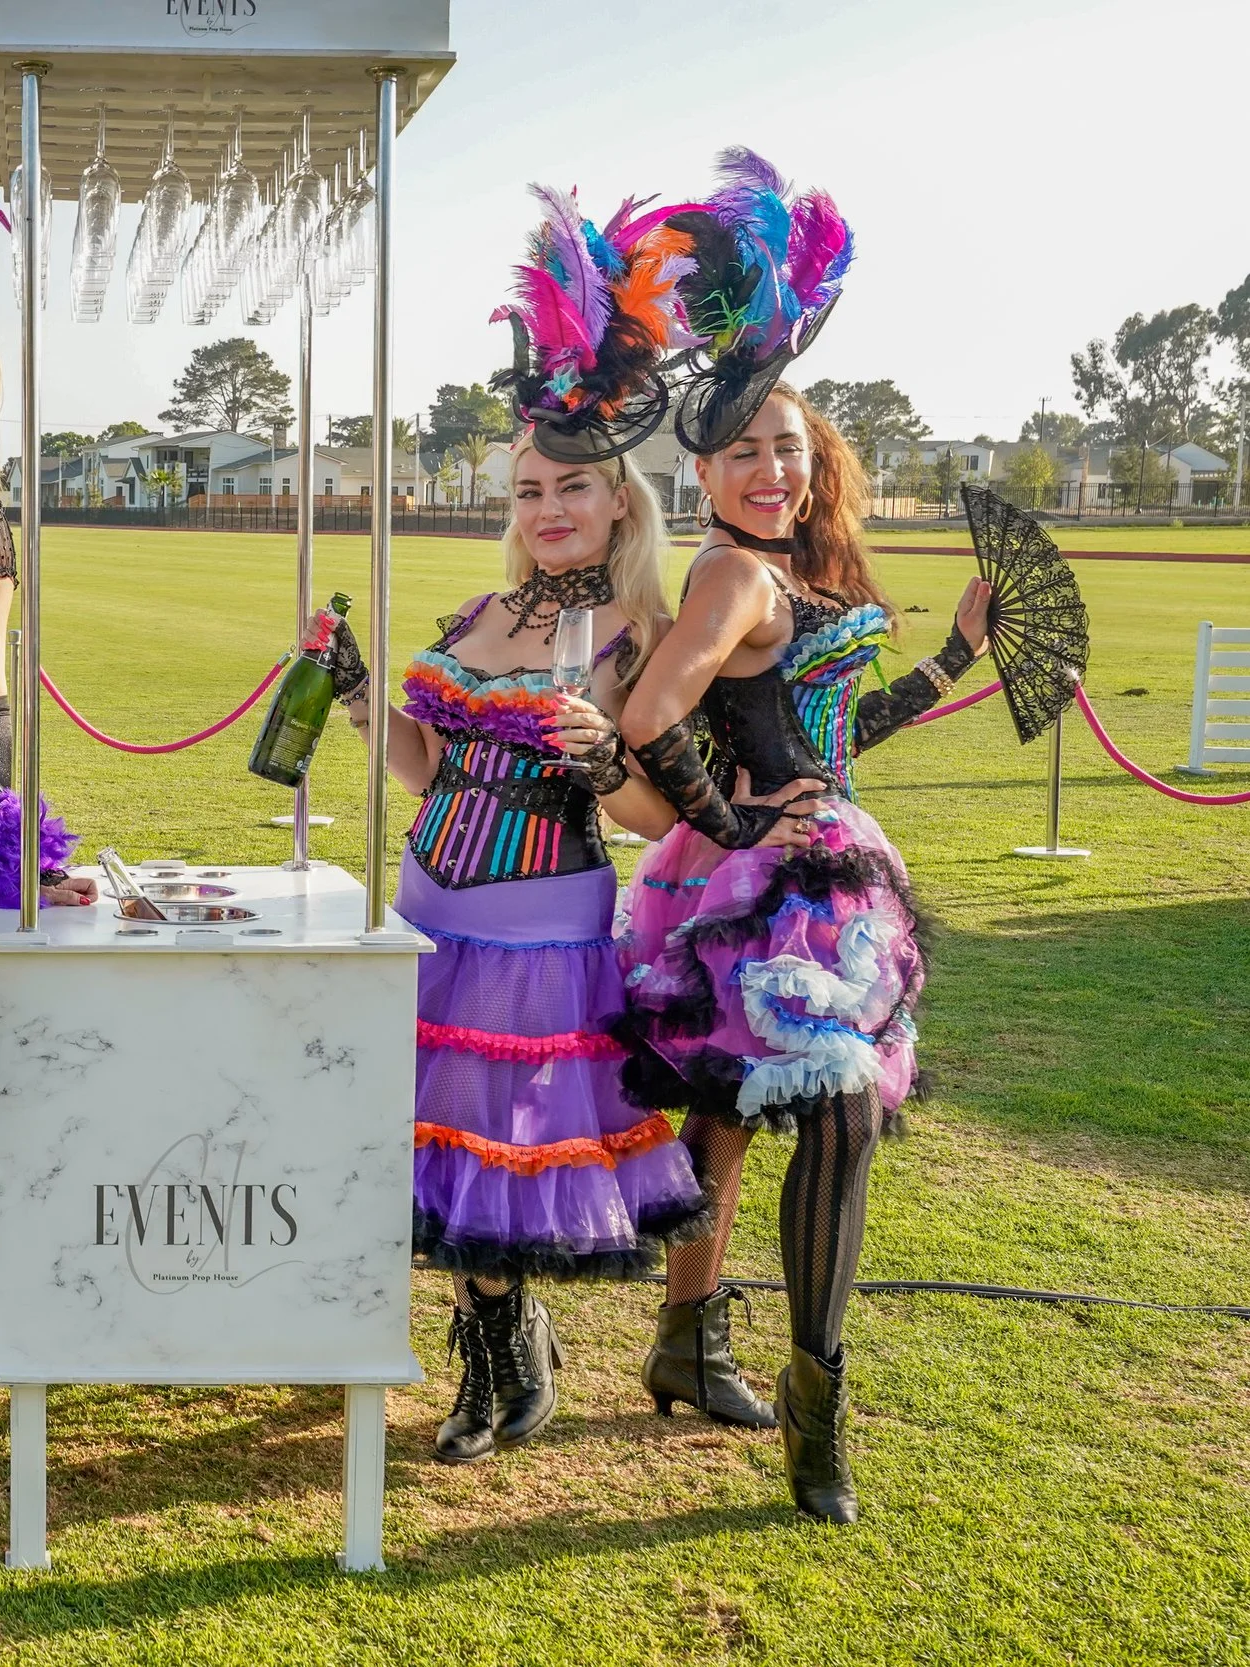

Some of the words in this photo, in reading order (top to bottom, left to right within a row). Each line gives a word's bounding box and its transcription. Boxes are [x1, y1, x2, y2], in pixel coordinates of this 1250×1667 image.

[93, 1184, 297, 1246] EVENTS
[186, 1249, 200, 1268] by
[153, 1273, 189, 1281] Platinum
[192, 1273, 210, 1283] Prop
[214, 1273, 238, 1281] House
